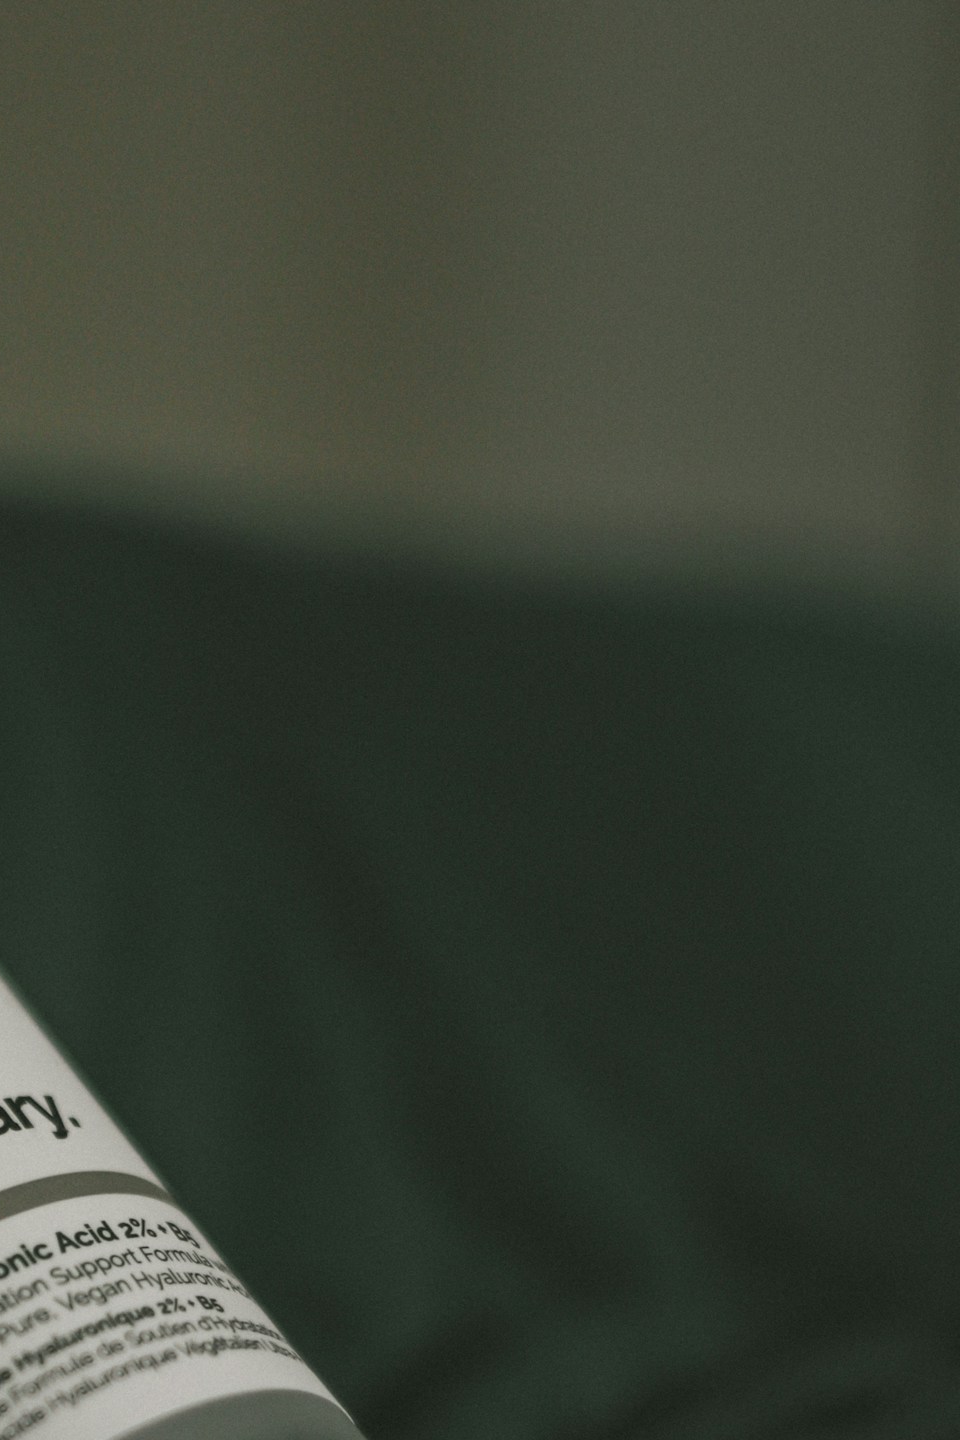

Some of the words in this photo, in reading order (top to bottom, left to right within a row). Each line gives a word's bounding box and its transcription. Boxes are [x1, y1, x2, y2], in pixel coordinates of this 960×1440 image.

[55, 1220, 119, 1254] Acid
[118, 1218, 157, 1239] 2%
[166, 1221, 201, 1249] B5
[49, 1249, 142, 1286] Support
[138, 1246, 214, 1268] Formula
[54, 1278, 131, 1311] Vegan
[131, 1268, 230, 1291] Hyaluronic
[157, 1298, 186, 1315] 2%
[196, 1295, 224, 1313] B5
[96, 1338, 125, 1358] de
